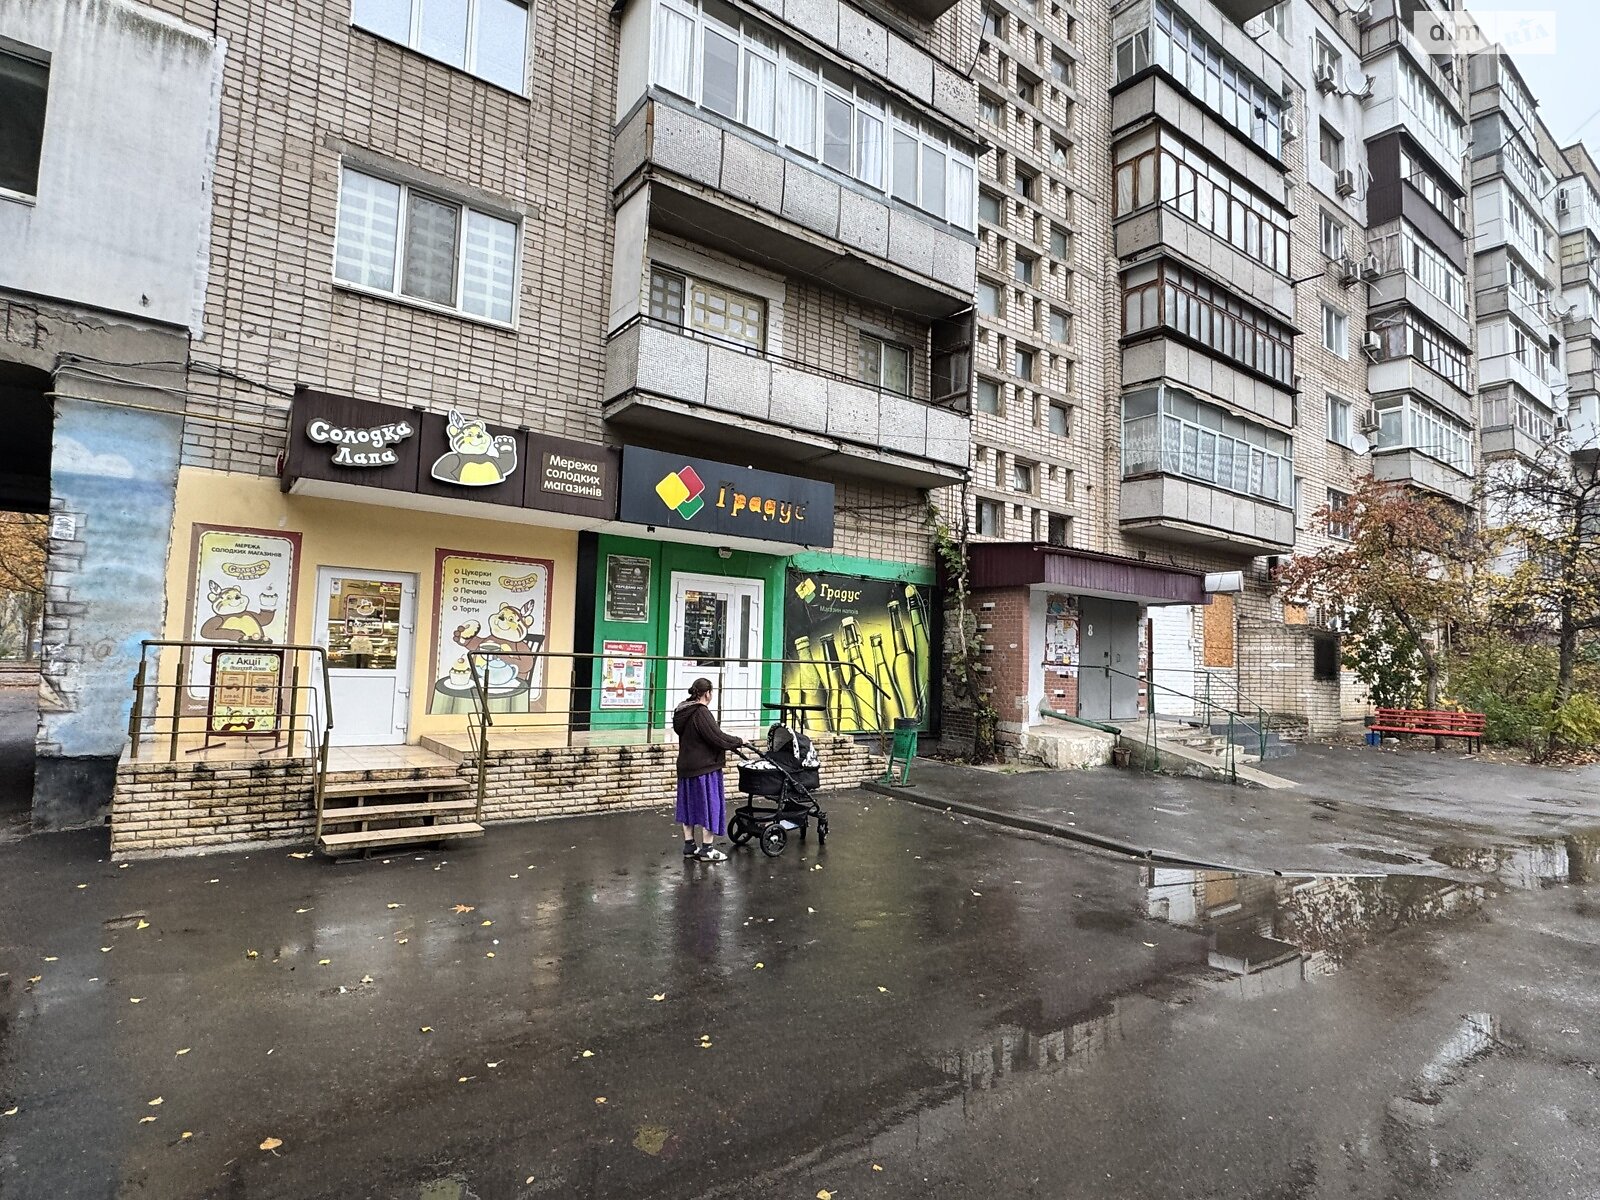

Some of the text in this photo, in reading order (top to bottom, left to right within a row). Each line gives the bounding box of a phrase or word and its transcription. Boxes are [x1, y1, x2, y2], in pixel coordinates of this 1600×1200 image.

[310, 421, 411, 448] Солодка
[335, 447, 396, 464] Лапа
[550, 454, 598, 473] Мережа
[546, 468, 600, 485] солодких
[544, 480, 602, 497] магазинів
[211, 546, 282, 558] СОЛОДКИХ МАГАЗИНІВ
[461, 568, 492, 577] Цукерки
[461, 577, 491, 586] Тістечка
[460, 587, 487, 596] Печиво
[820, 583, 860, 602] Градус
[460, 596, 487, 605] Горішки
[460, 605, 480, 614] Торти
[1088, 624, 1093, 636] 8
[236, 657, 262, 666] Акції
